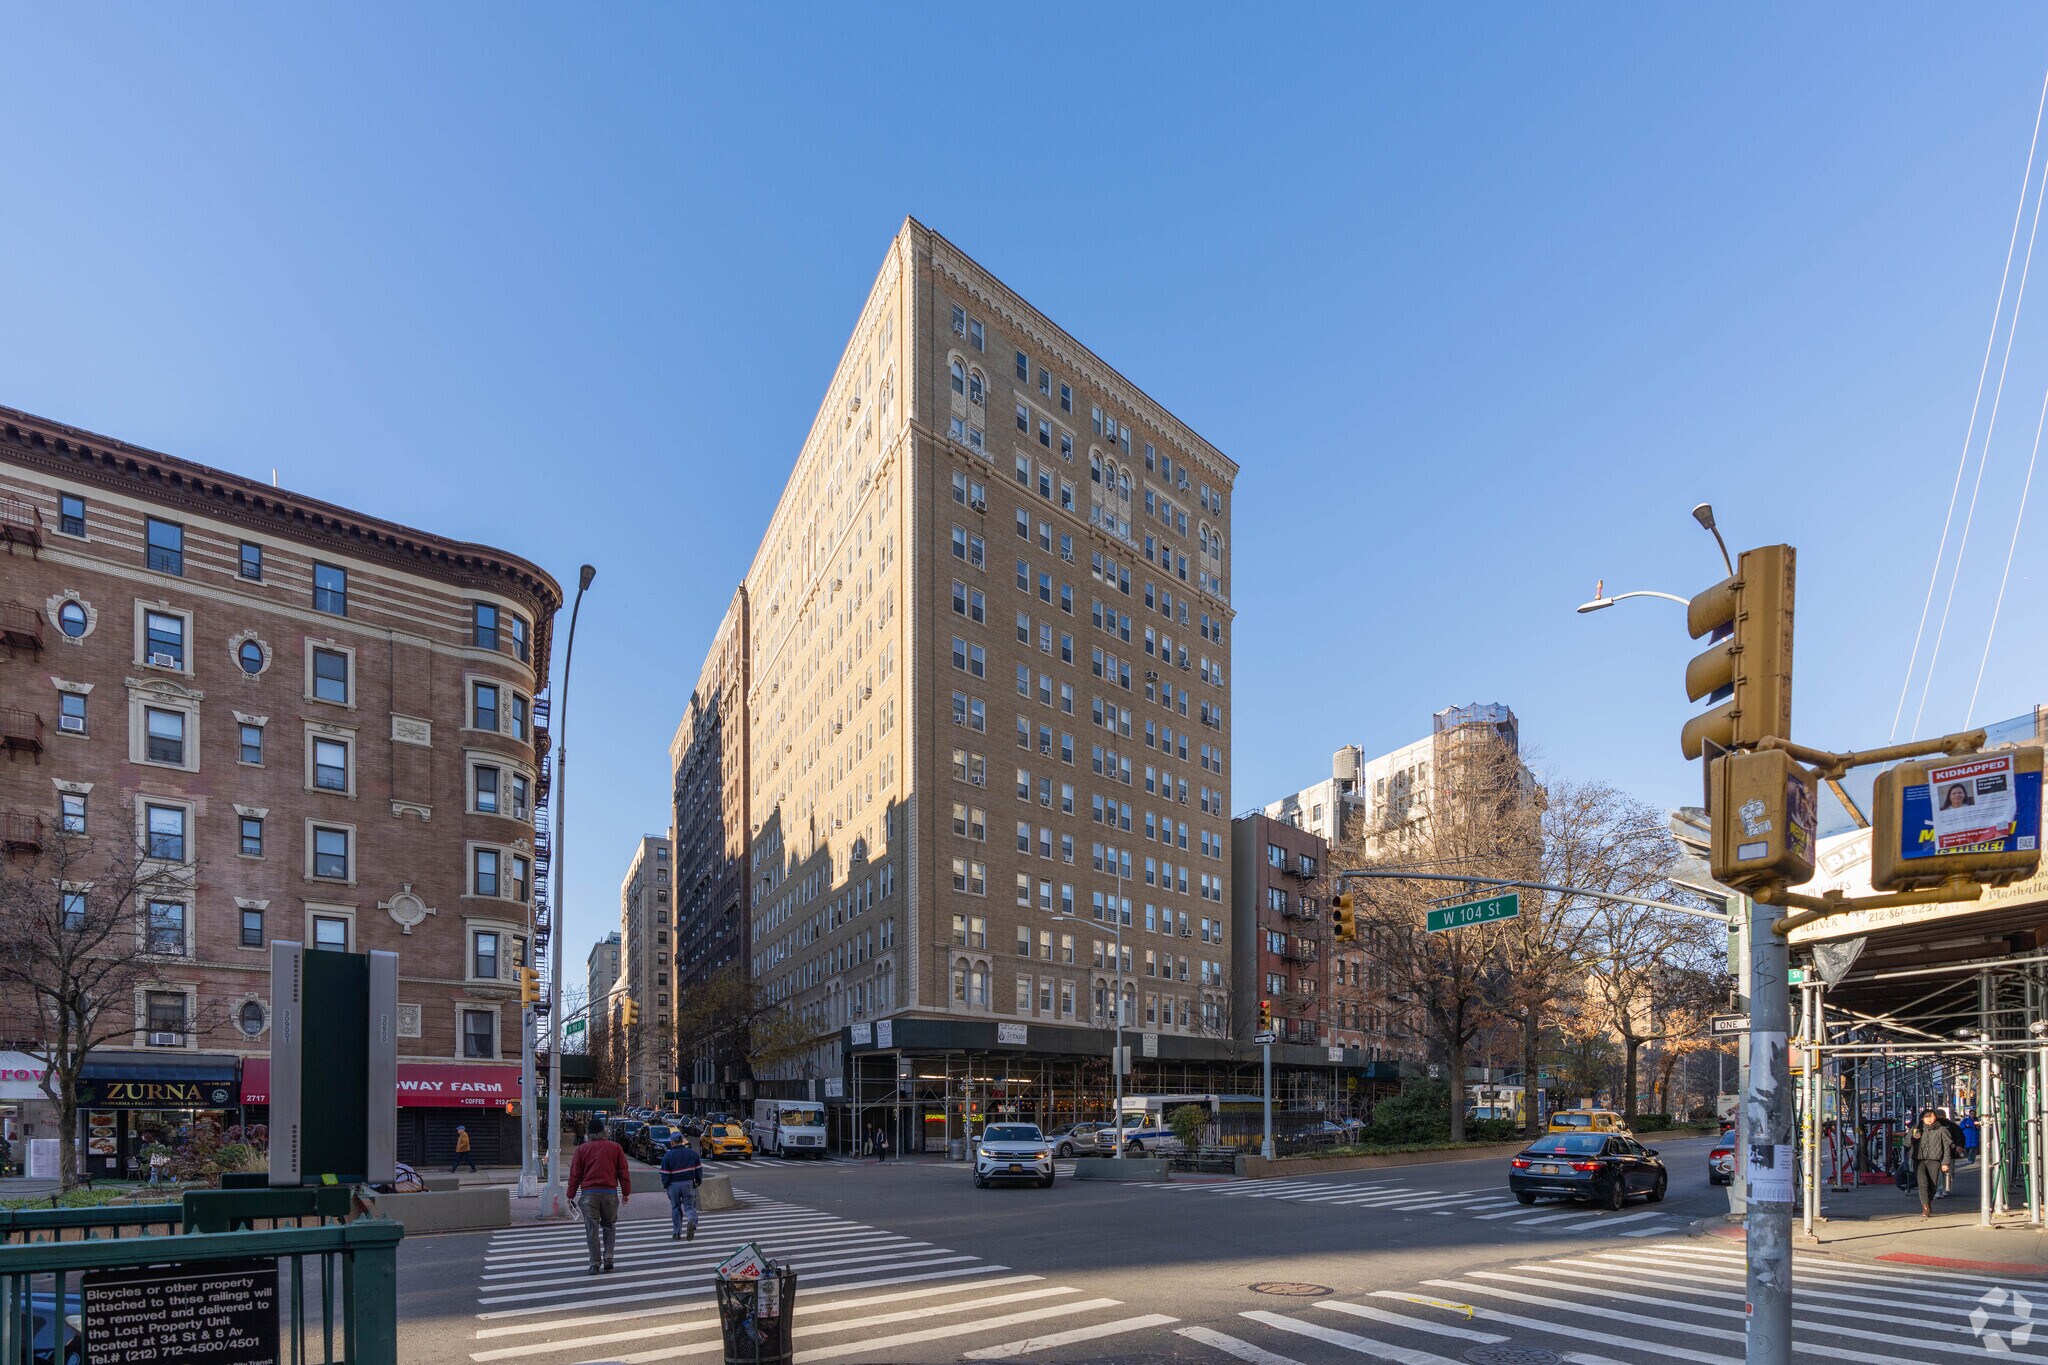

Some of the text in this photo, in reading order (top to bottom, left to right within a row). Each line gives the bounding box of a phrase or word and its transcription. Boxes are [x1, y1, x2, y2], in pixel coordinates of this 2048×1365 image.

[1935, 760, 2006, 780] KIDNAPPED
[1955, 841, 2003, 853] HERE!
[1443, 901, 1500, 925] W 104 St
[1868, 902, 1939, 923] 212-866-6237
[1720, 1020, 1738, 1029] ONE
[107, 1082, 203, 1100] ZURNA
[246, 1094, 265, 1102] 2717
[451, 1082, 503, 1092] FARM
[86, 1277, 254, 1301] Bicycles or other property
[87, 1287, 273, 1313] attached to these railings will
[87, 1300, 270, 1326] be removed and delivered to
[88, 1316, 231, 1339] the Lost Property Unit
[88, 1327, 243, 1353] located at 34 St & 8 Av
[89, 1336, 260, 1365] Tel.# (212) 712-4500/4501
